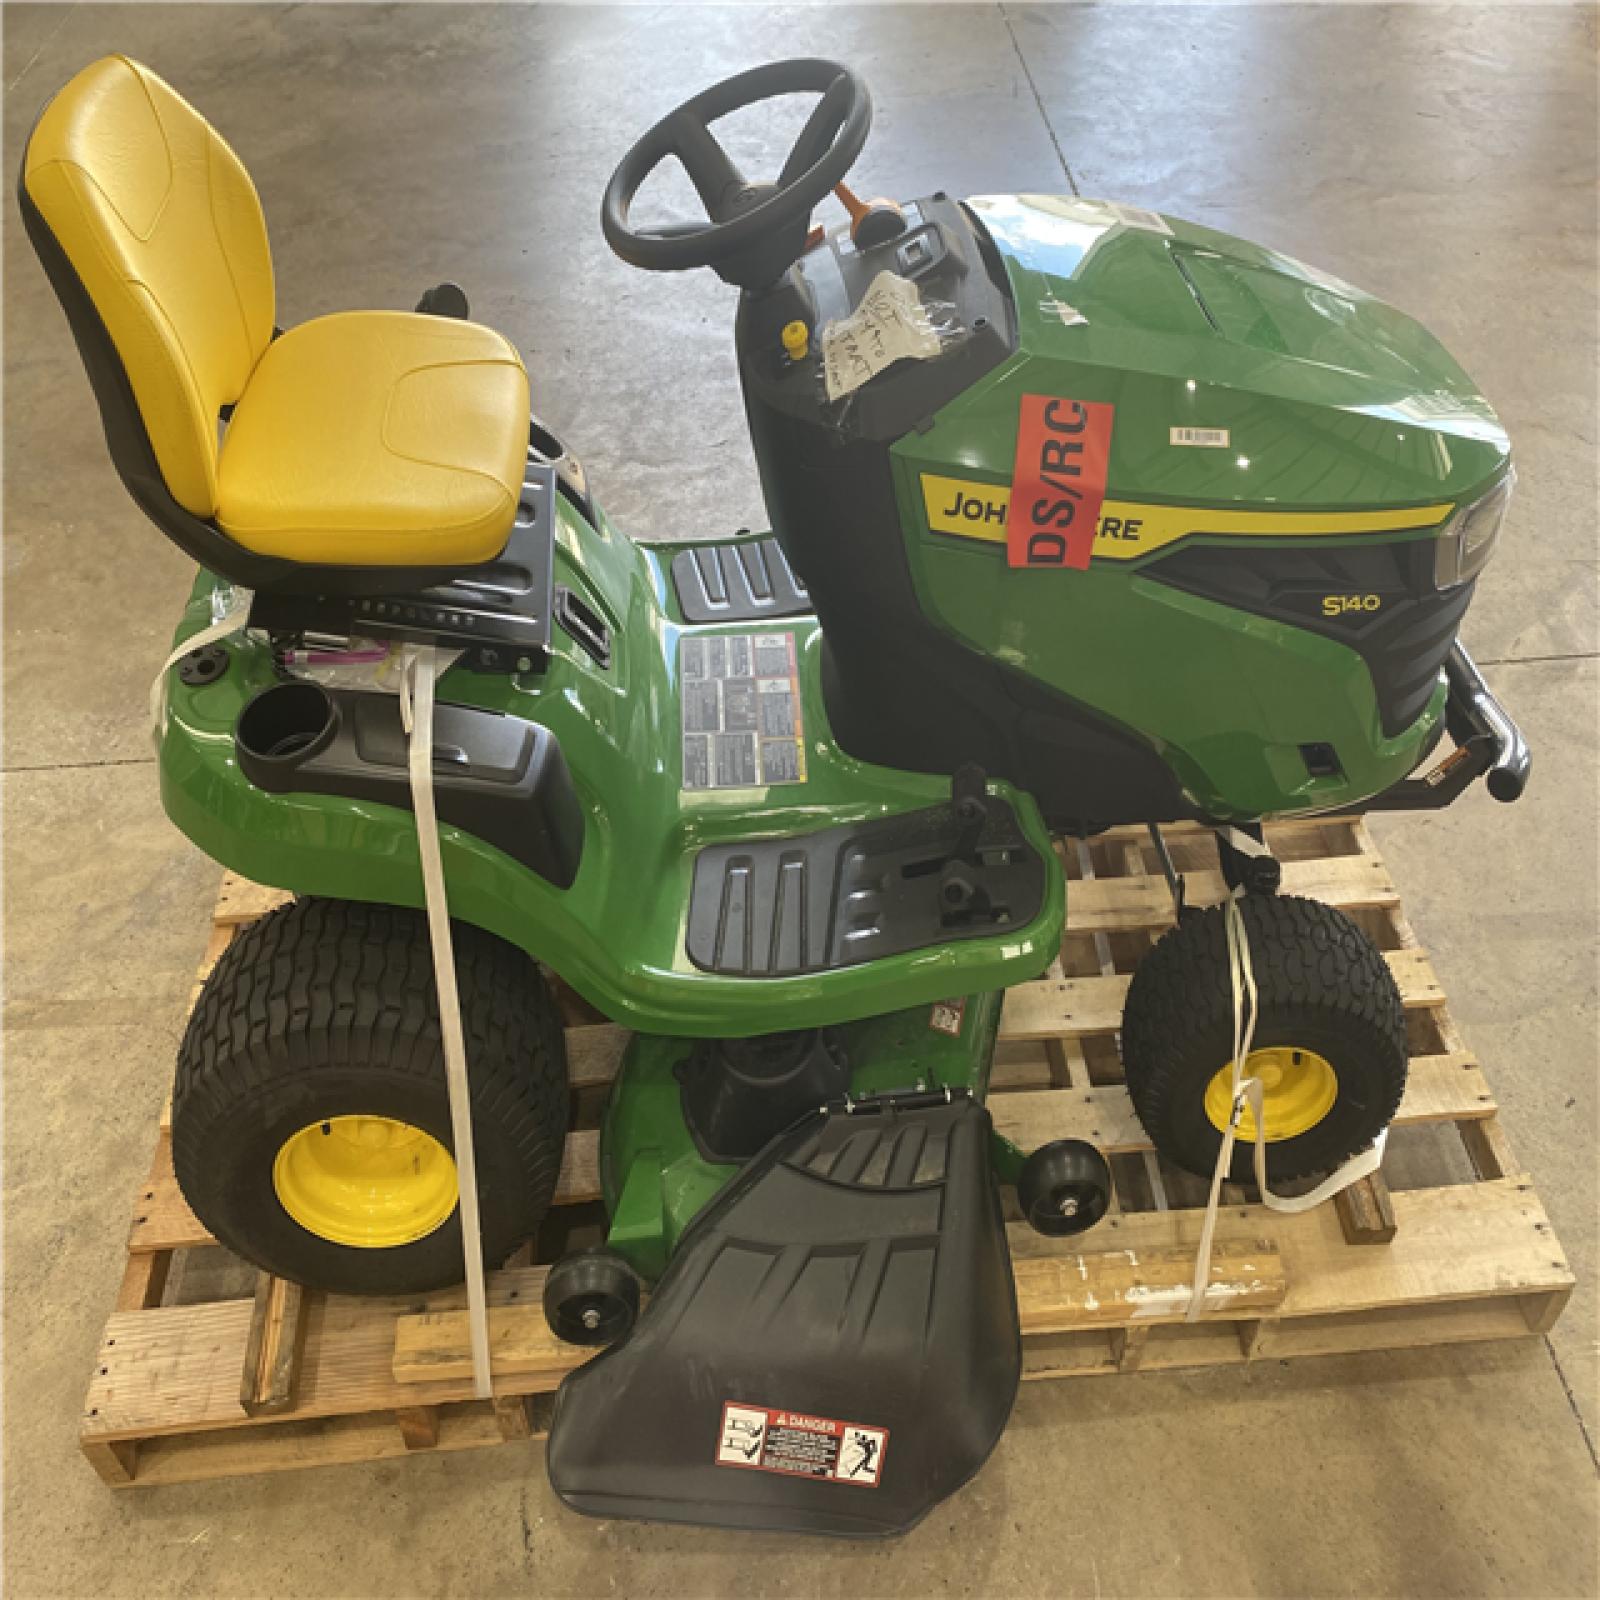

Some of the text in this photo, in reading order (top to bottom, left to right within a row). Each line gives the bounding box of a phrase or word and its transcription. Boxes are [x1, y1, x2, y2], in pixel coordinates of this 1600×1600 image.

[1027, 399, 1089, 564] DS/RC
[944, 491, 1006, 525] JOH
[1321, 594, 1381, 616] S140
